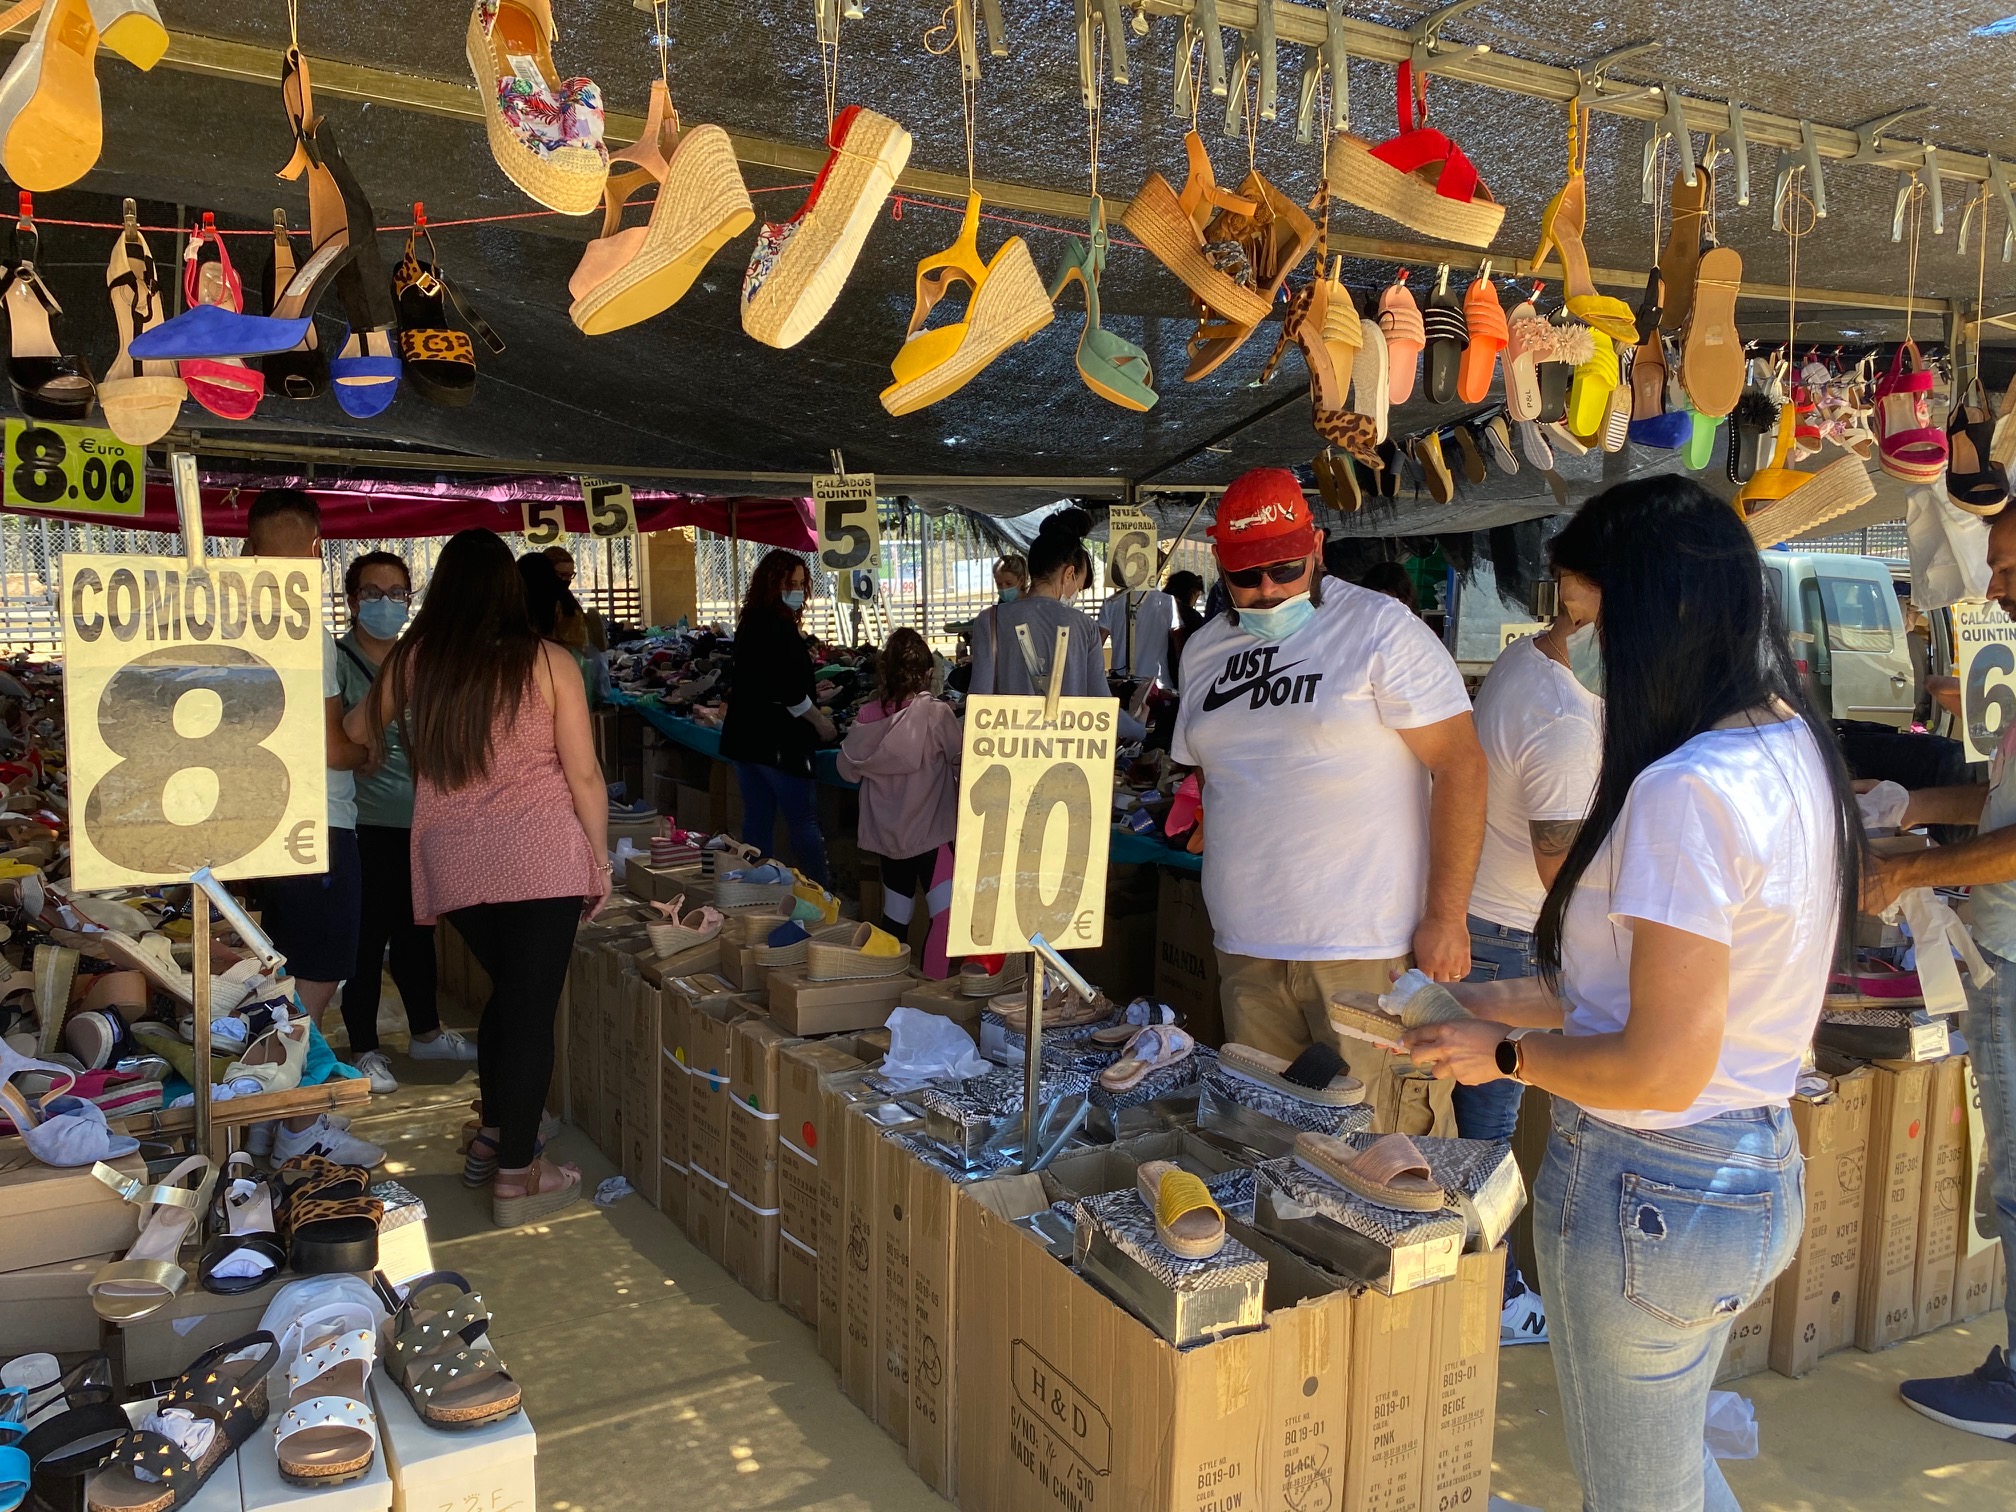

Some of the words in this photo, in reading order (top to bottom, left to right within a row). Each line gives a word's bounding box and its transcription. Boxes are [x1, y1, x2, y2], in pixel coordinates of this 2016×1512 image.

[13, 426, 134, 503] 8.00
[816, 478, 872, 488] CALZADOS
[816, 488, 872, 499] QUINTIN
[591, 484, 629, 536] 5
[527, 503, 560, 544] 5
[822, 500, 871, 569] 5
[870, 554, 878, 566] €
[1110, 521, 1156, 531] TEMPORADA
[1110, 531, 1150, 588] 6
[1147, 575, 1156, 588] €
[71, 567, 311, 643] COMODOS
[1960, 611, 2016, 625] CALZADO
[1962, 627, 2016, 642] QUINTIN
[1218, 645, 1280, 686] JUST
[1965, 643, 2016, 756] 6
[974, 708, 1111, 732] CALZADOS
[84, 644, 291, 875] 8
[284, 819, 318, 865] €
[972, 737, 1108, 760] QUINTIN
[969, 761, 1092, 946] 10
[1073, 909, 1095, 940] €
[1937, 1147, 1962, 1166] HD-305
[1891, 1188, 1905, 1203] RED
[1836, 1220, 1858, 1239] BLACK
[1831, 1247, 1857, 1268] HD-305
[1521, 1312, 1546, 1335] N
[1443, 1365, 1477, 1388] BQ19-01
[1444, 1361, 1458, 1372] STYLE
[1374, 1395, 1411, 1419] BQ19-01
[1375, 1391, 1391, 1403] STYLE
[1442, 1396, 1466, 1417] BEIGE
[1284, 1415, 1301, 1427] STYLE
[1373, 1430, 1395, 1450] PINK
[1010, 1431, 1035, 1474] MADE
[1039, 1461, 1049, 1488] IN
[1053, 1476, 1083, 1512] CHINA
[1197, 1462, 1241, 1489] BQ19-01
[1198, 1459, 1217, 1472] STYLE
[1284, 1454, 1316, 1478] BLACK
